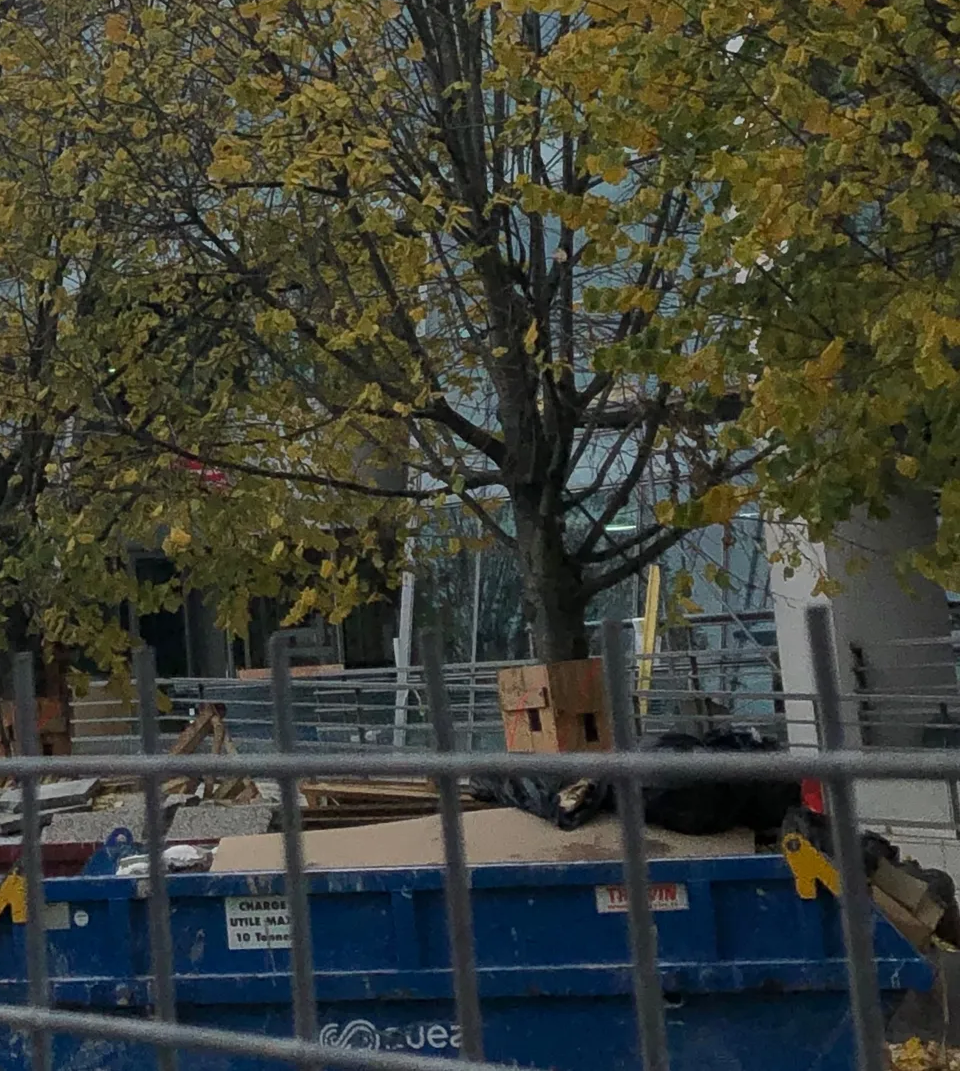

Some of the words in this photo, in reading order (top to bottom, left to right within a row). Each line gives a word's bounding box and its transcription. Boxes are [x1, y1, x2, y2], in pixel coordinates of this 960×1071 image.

[239, 900, 287, 912] CHARGE
[230, 916, 261, 927] UTILE
[236, 932, 251, 943] 10
